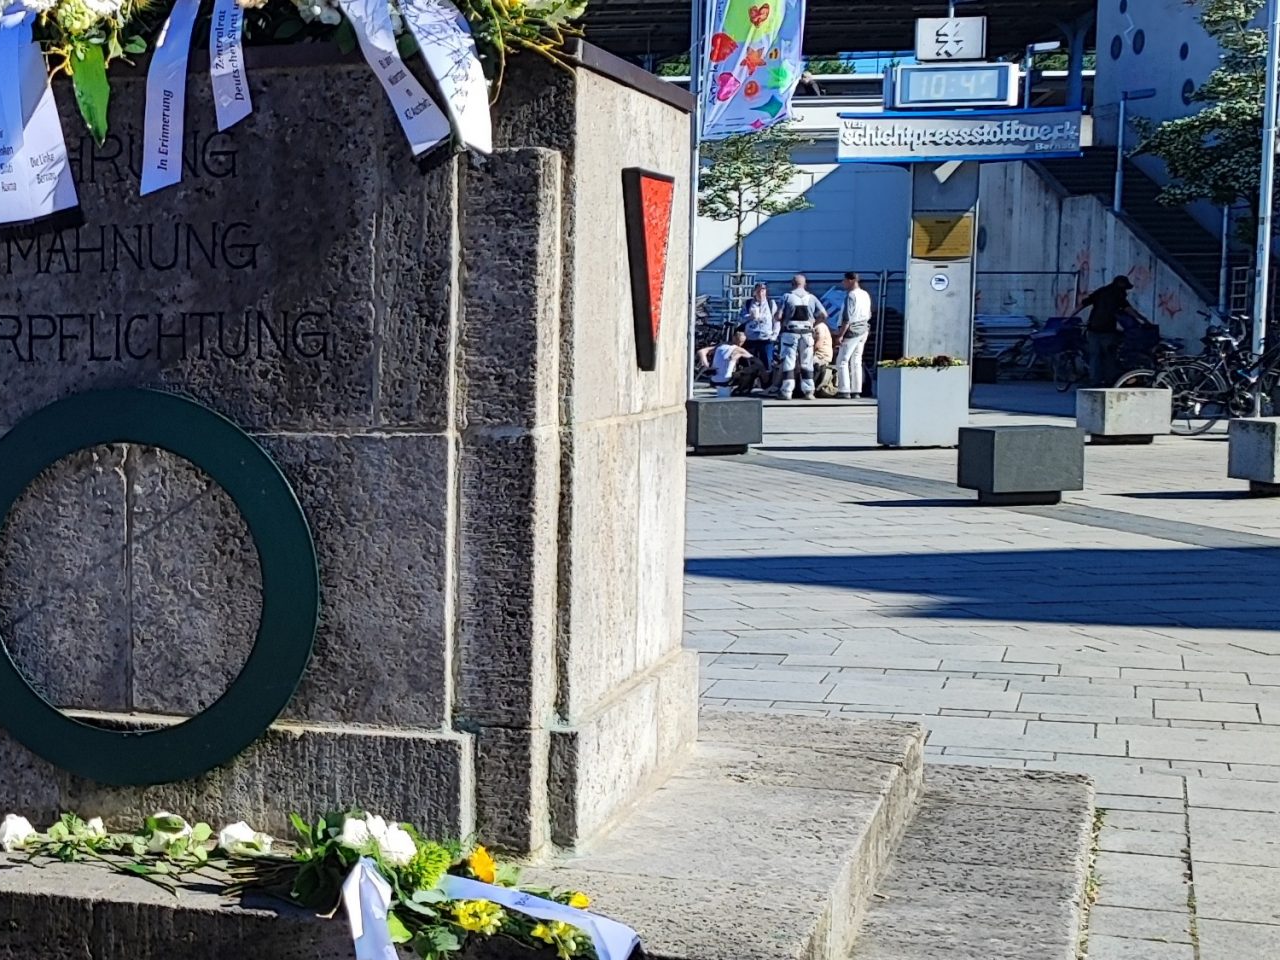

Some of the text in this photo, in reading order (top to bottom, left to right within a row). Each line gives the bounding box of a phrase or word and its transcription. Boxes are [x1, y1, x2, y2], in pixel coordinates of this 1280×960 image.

[228, 41, 245, 101] Deutscher
[157, 89, 173, 171] In Erinnerung
[843, 121, 864, 129] VEB
[5, 221, 261, 274] MAHNUNG
